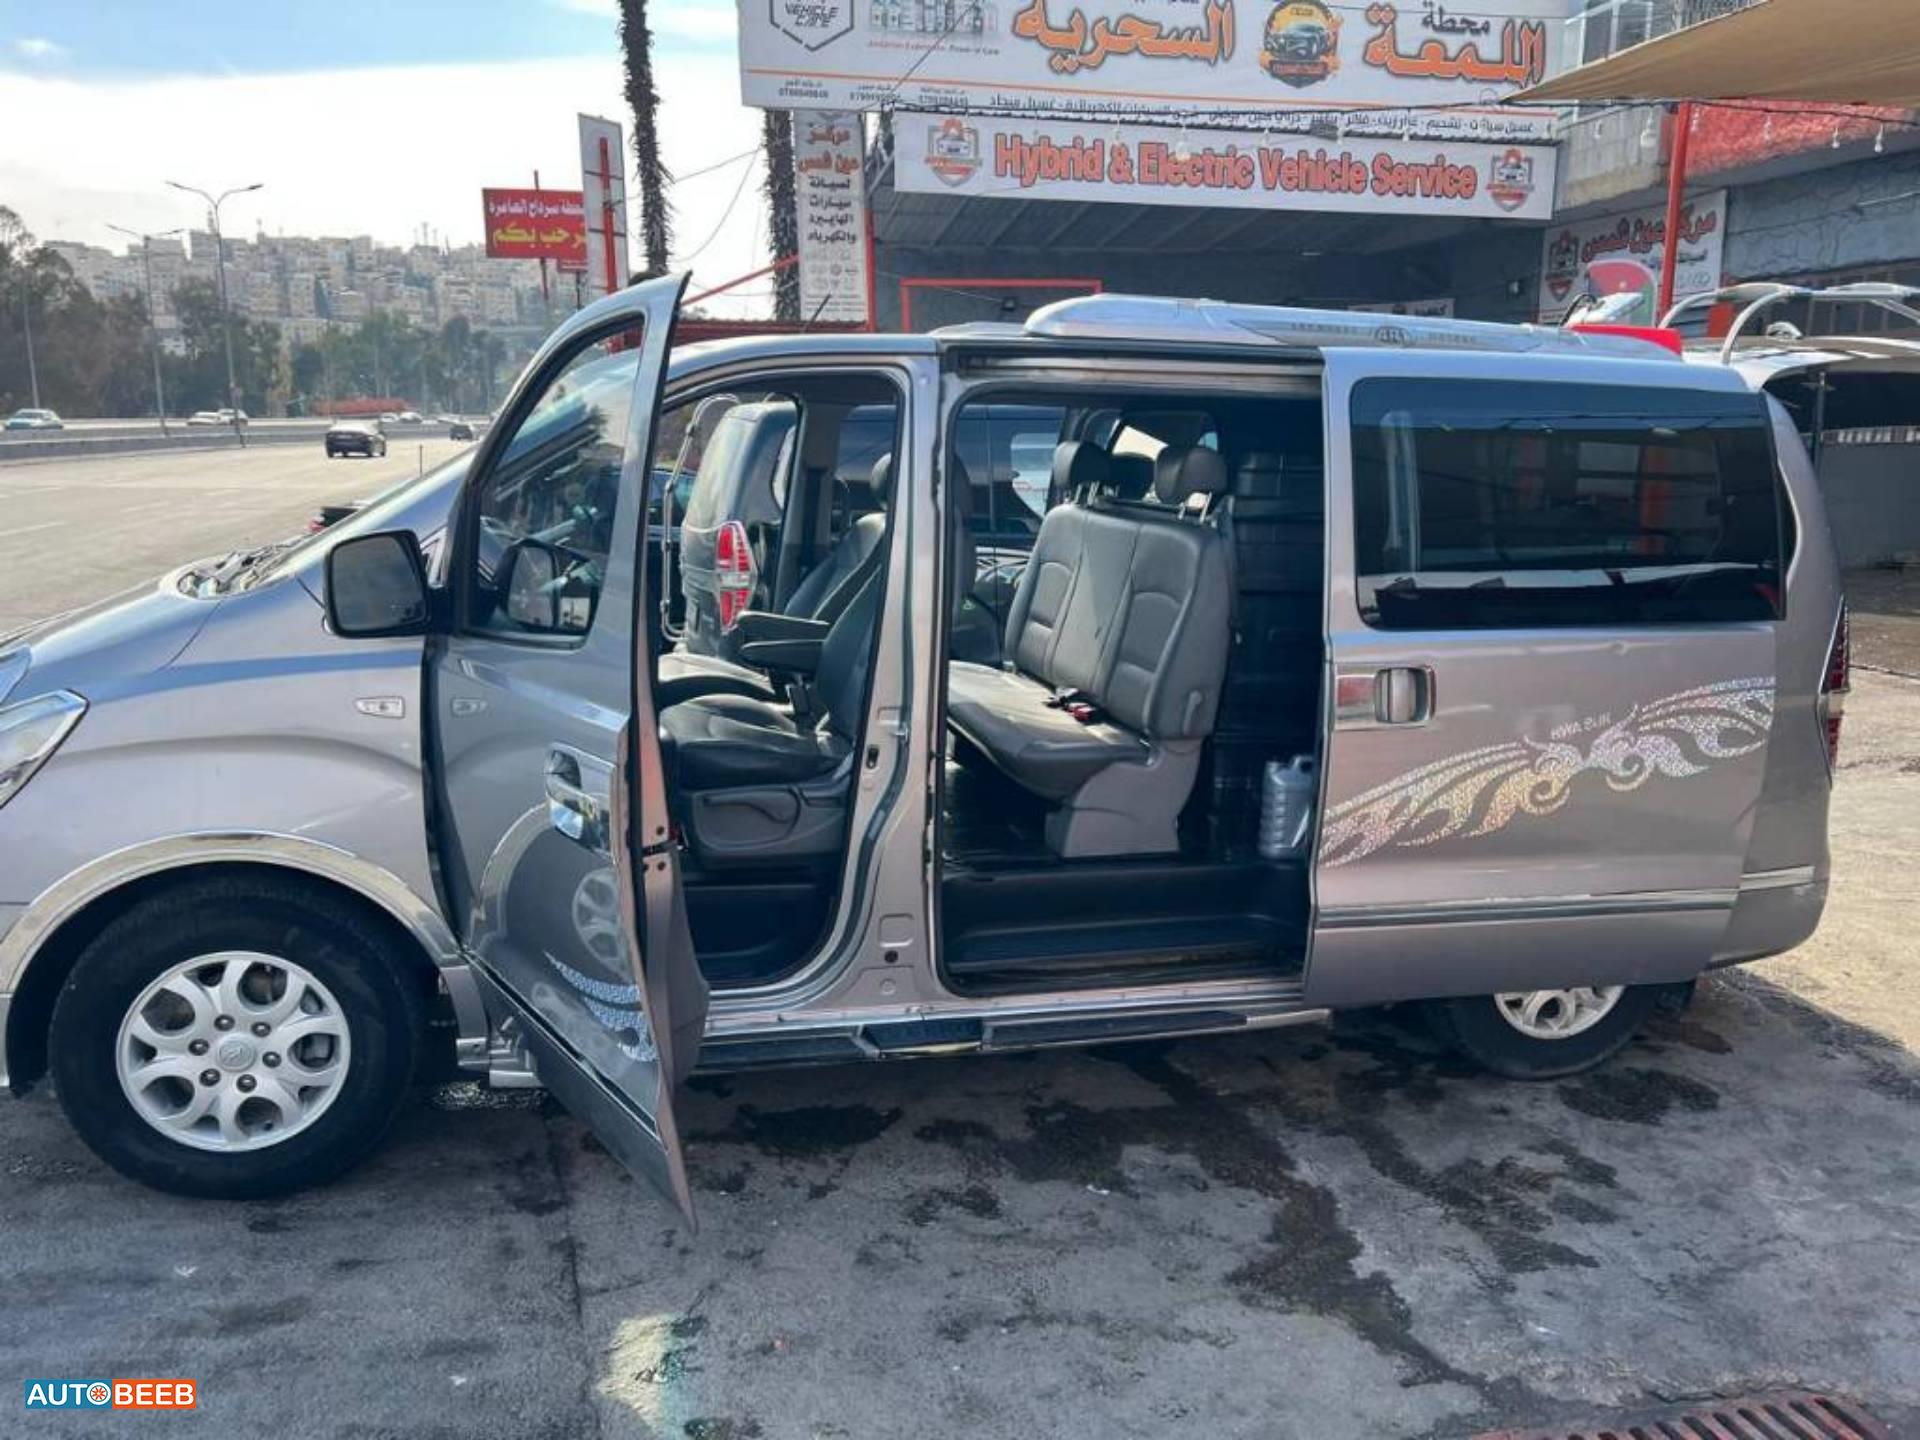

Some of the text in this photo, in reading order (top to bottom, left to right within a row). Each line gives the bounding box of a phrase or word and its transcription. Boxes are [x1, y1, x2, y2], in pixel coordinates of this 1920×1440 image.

[1012, 0, 1235, 74] السحرية
[1363, 2, 1545, 89] اللمعة
[1422, 0, 1490, 34] محطة
[995, 132, 1104, 187] Hybrid
[1109, 143, 1133, 183] &
[1138, 141, 1254, 192] Electric
[1258, 146, 1367, 194] Vehicle
[1371, 152, 1477, 199] Service
